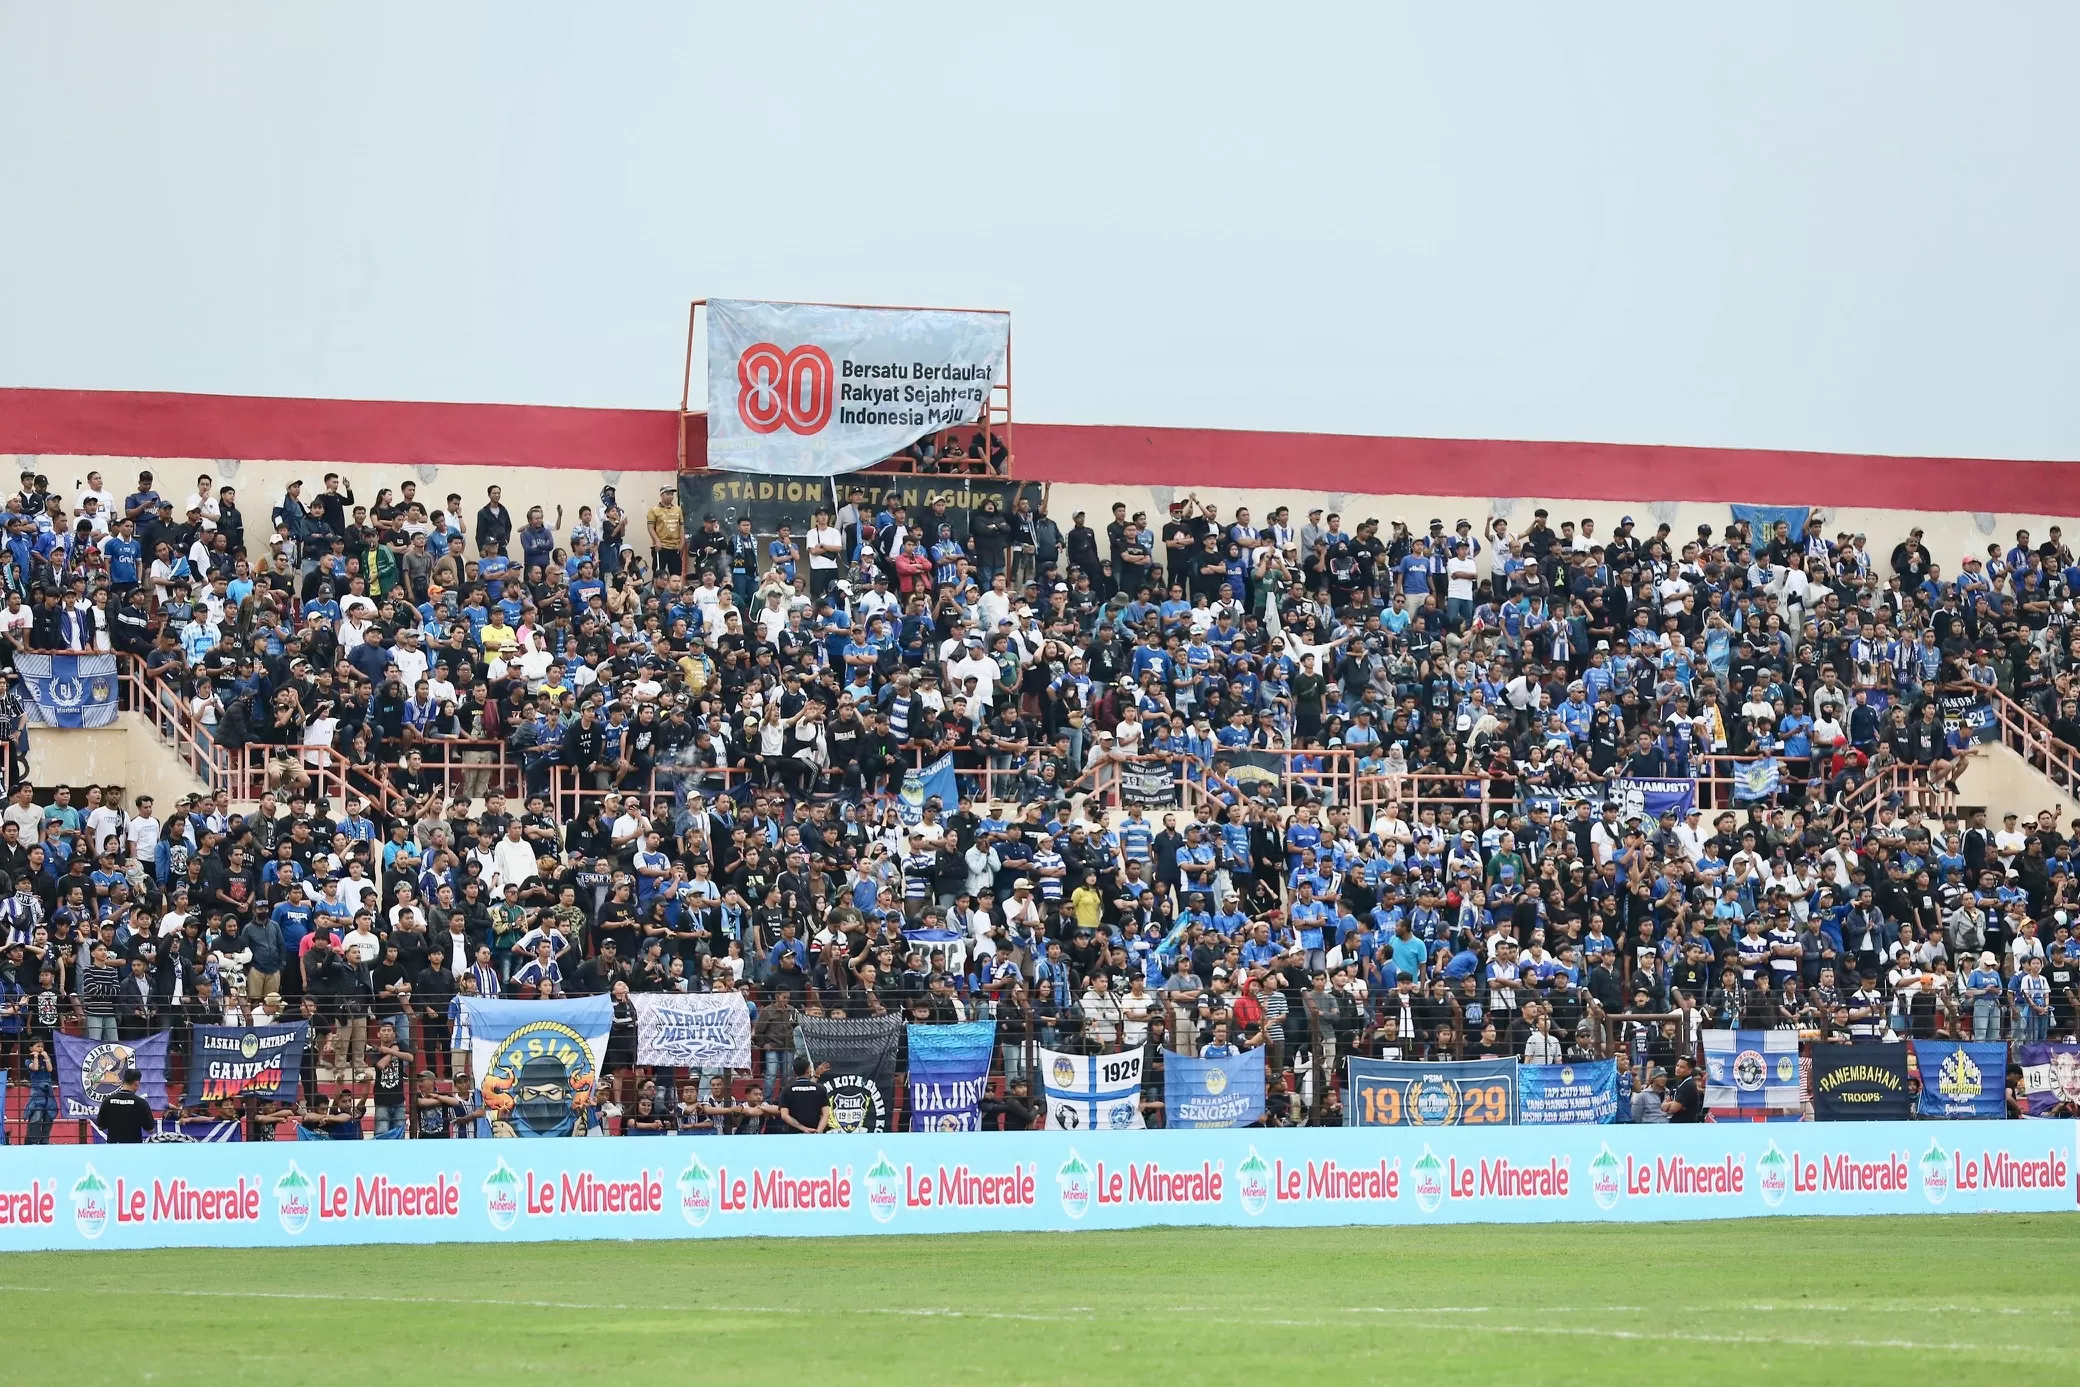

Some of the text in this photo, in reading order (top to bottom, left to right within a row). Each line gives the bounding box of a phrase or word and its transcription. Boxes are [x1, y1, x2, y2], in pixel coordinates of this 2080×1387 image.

[842, 360, 991, 381] Bersatu Berdaulat
[737, 342, 835, 436] 80
[841, 383, 983, 407] Rakyat Sejahtera
[840, 404, 963, 427] Indonesia Maju
[712, 481, 823, 502] STADION
[923, 488, 1004, 511] AGUNG
[1968, 709, 1986, 727] 29
[655, 1007, 731, 1026] TERROR
[656, 1026, 731, 1045] MENTAL
[204, 1035, 240, 1051] LASKAR
[83, 1044, 112, 1072] BAJING
[508, 1038, 579, 1071] PSIM
[1103, 1058, 1140, 1083] 1929
[834, 1075, 863, 1088] KOTA
[1423, 1074, 1443, 1083] PSIM
[1820, 1065, 1900, 1093] PANEMBAHAN
[1544, 1085, 1593, 1098] TAPI SATU HAL
[838, 1098, 861, 1108] PSIM
[1191, 1092, 1240, 1105] BRAJAMUSTI
[1463, 1086, 1506, 1123] 29
[1526, 1099, 1544, 1111] YANG
[1545, 1099, 1568, 1110] HARUS
[1570, 1097, 1590, 1109] KAMU
[1361, 1087, 1401, 1124] 19
[838, 1112, 847, 1120] 19
[851, 1112, 861, 1120] 29
[1543, 1111, 1557, 1122] ADA
[1559, 1110, 1575, 1122] HATI
[1576, 1108, 1594, 1121] YANG
[1627, 1156, 1744, 1194] Le Minerale
[1770, 1170, 1776, 1180] Le
[1794, 1154, 1908, 1191] Le Minerale
[1932, 1168, 1938, 1178] Le
[1956, 1151, 2066, 1189] Le Minerale
[1098, 1163, 1222, 1202] Le Minerale
[1250, 1178, 1257, 1188] Le
[1277, 1161, 1398, 1199] Le Minerale
[1425, 1175, 1432, 1186] Le
[1451, 1159, 1569, 1197] Le Minerale
[1602, 1172, 1610, 1183] Le
[1925, 1176, 1947, 1186] Minerale
[721, 1168, 851, 1210] Le Minerale
[880, 1184, 886, 1194] Le
[907, 1166, 1035, 1206] Le Minerale
[1072, 1180, 1078, 1191] Le
[1417, 1185, 1440, 1194] Minerale
[1594, 1182, 1618, 1192] Minerale
[1762, 1180, 1785, 1189] Minerale
[321, 1175, 459, 1217] Le Minerale
[499, 1190, 506, 1201] Le
[528, 1172, 662, 1213] Le Minerale
[692, 1186, 700, 1198] Le
[1063, 1190, 1088, 1200] Minerale
[1242, 1187, 1266, 1196] Minerale
[88, 1198, 95, 1209] Le
[118, 1178, 259, 1222] Le Minerale
[291, 1194, 298, 1205] Le
[684, 1198, 710, 1208] Minerale
[871, 1194, 896, 1204] Minerale
[282, 1204, 308, 1214] Minerale
[490, 1201, 516, 1211] Minerale
[78, 1208, 106, 1219] Minerale
